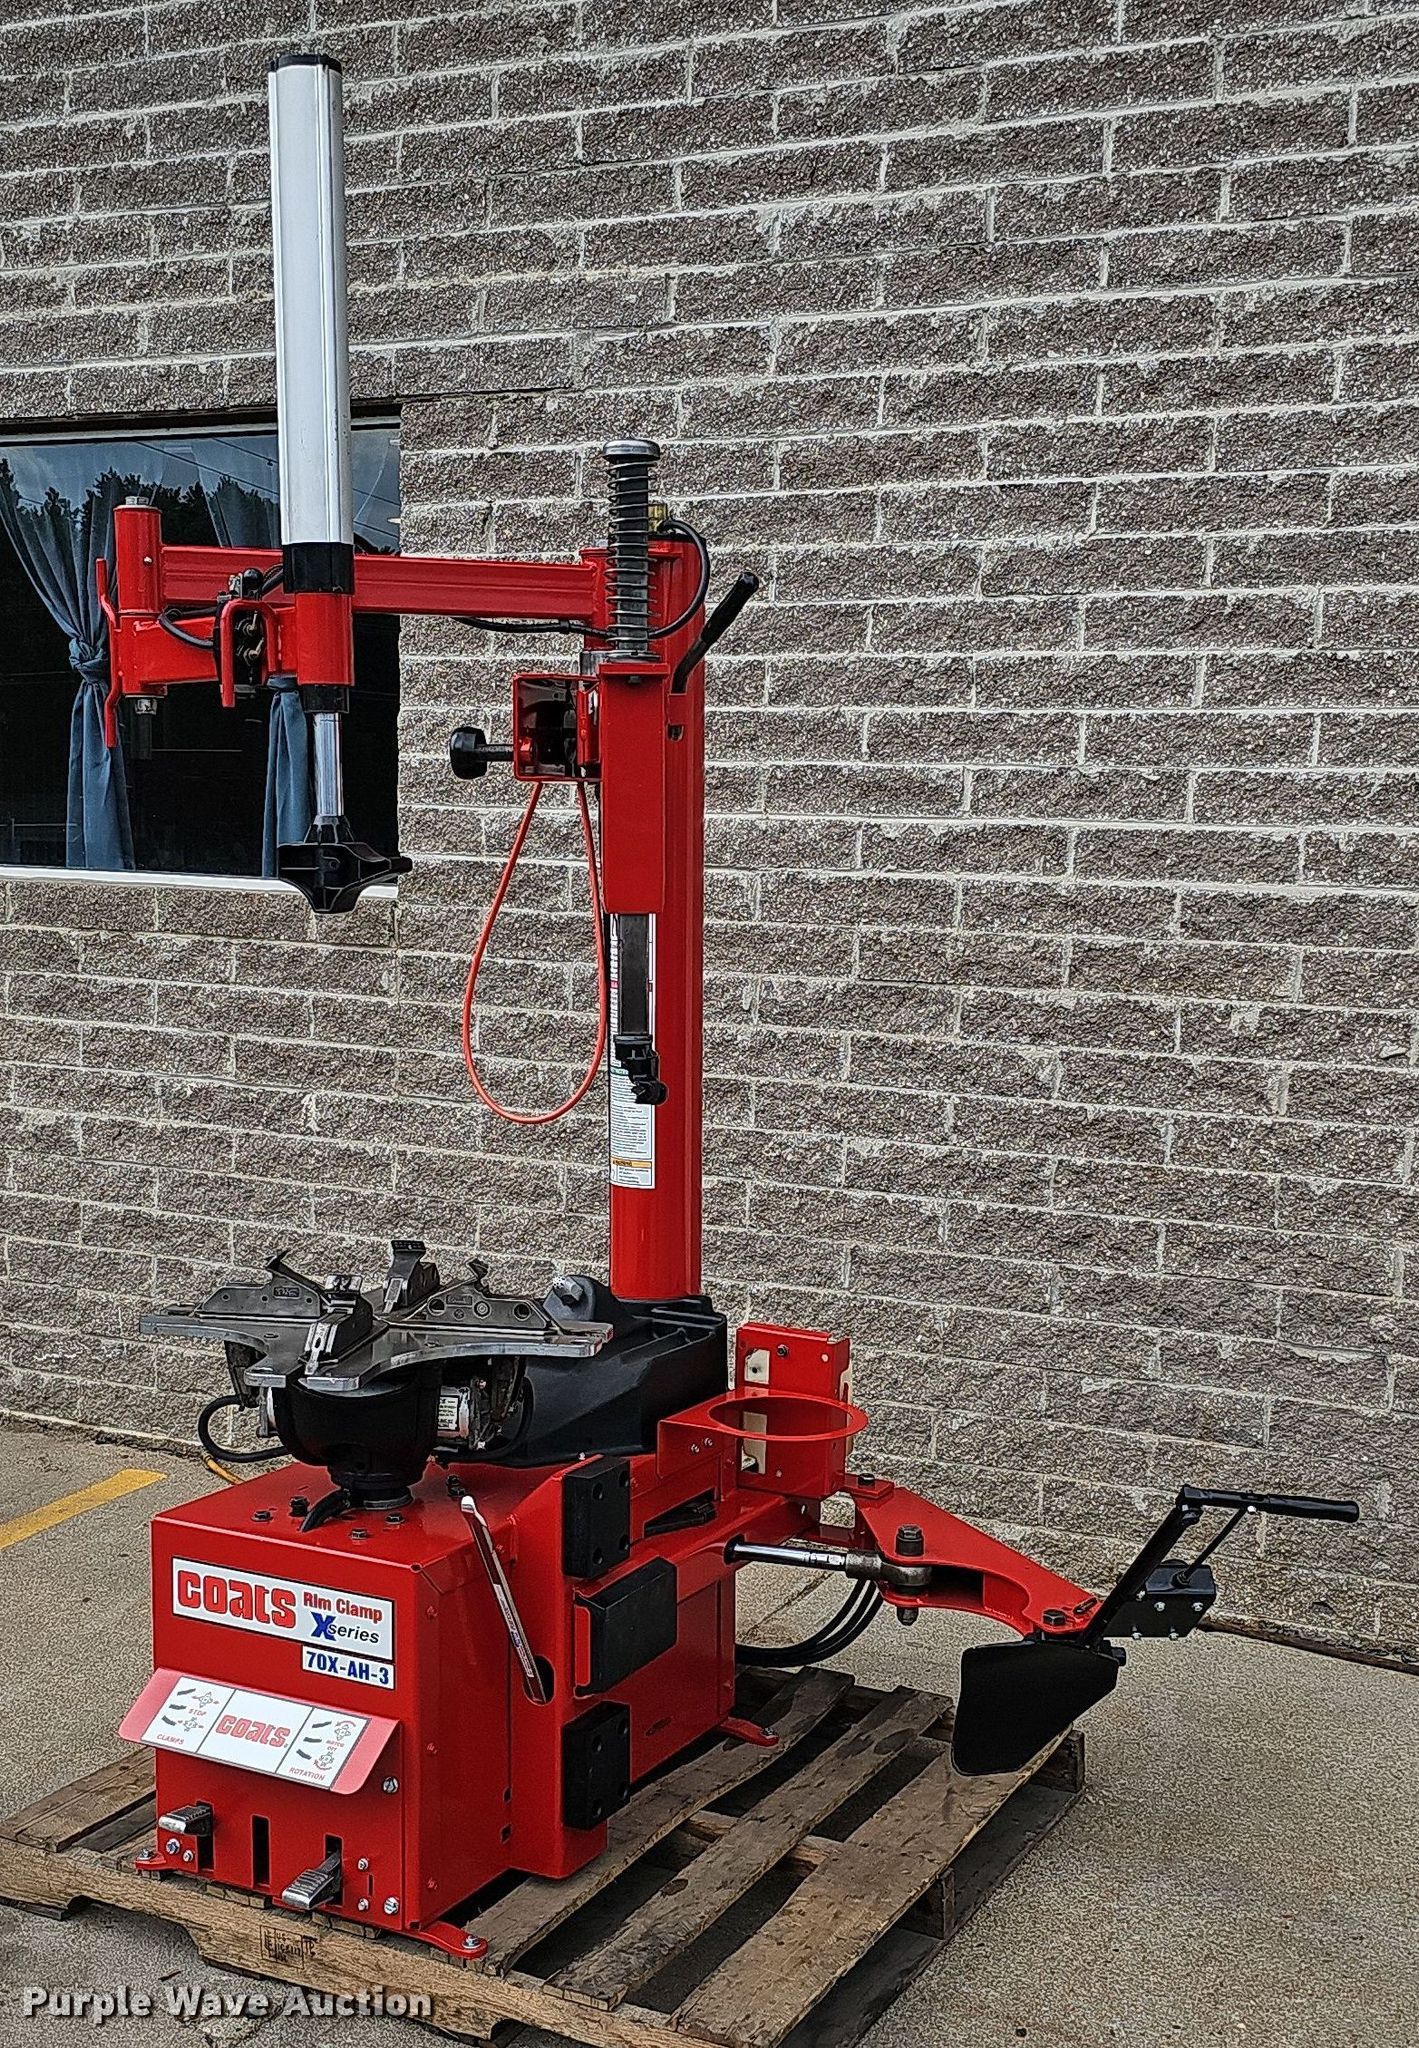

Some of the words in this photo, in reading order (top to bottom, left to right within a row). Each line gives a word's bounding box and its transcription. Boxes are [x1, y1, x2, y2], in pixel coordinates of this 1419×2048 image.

[304, 1592, 332, 1612] Rim
[336, 1598, 382, 1625] Clamp
[306, 1651, 389, 1685] 70X-AH-3
[188, 1708, 208, 1717] STOP
[156, 1733, 185, 1746] CLAMPS
[289, 1766, 326, 1781] ROTATION
